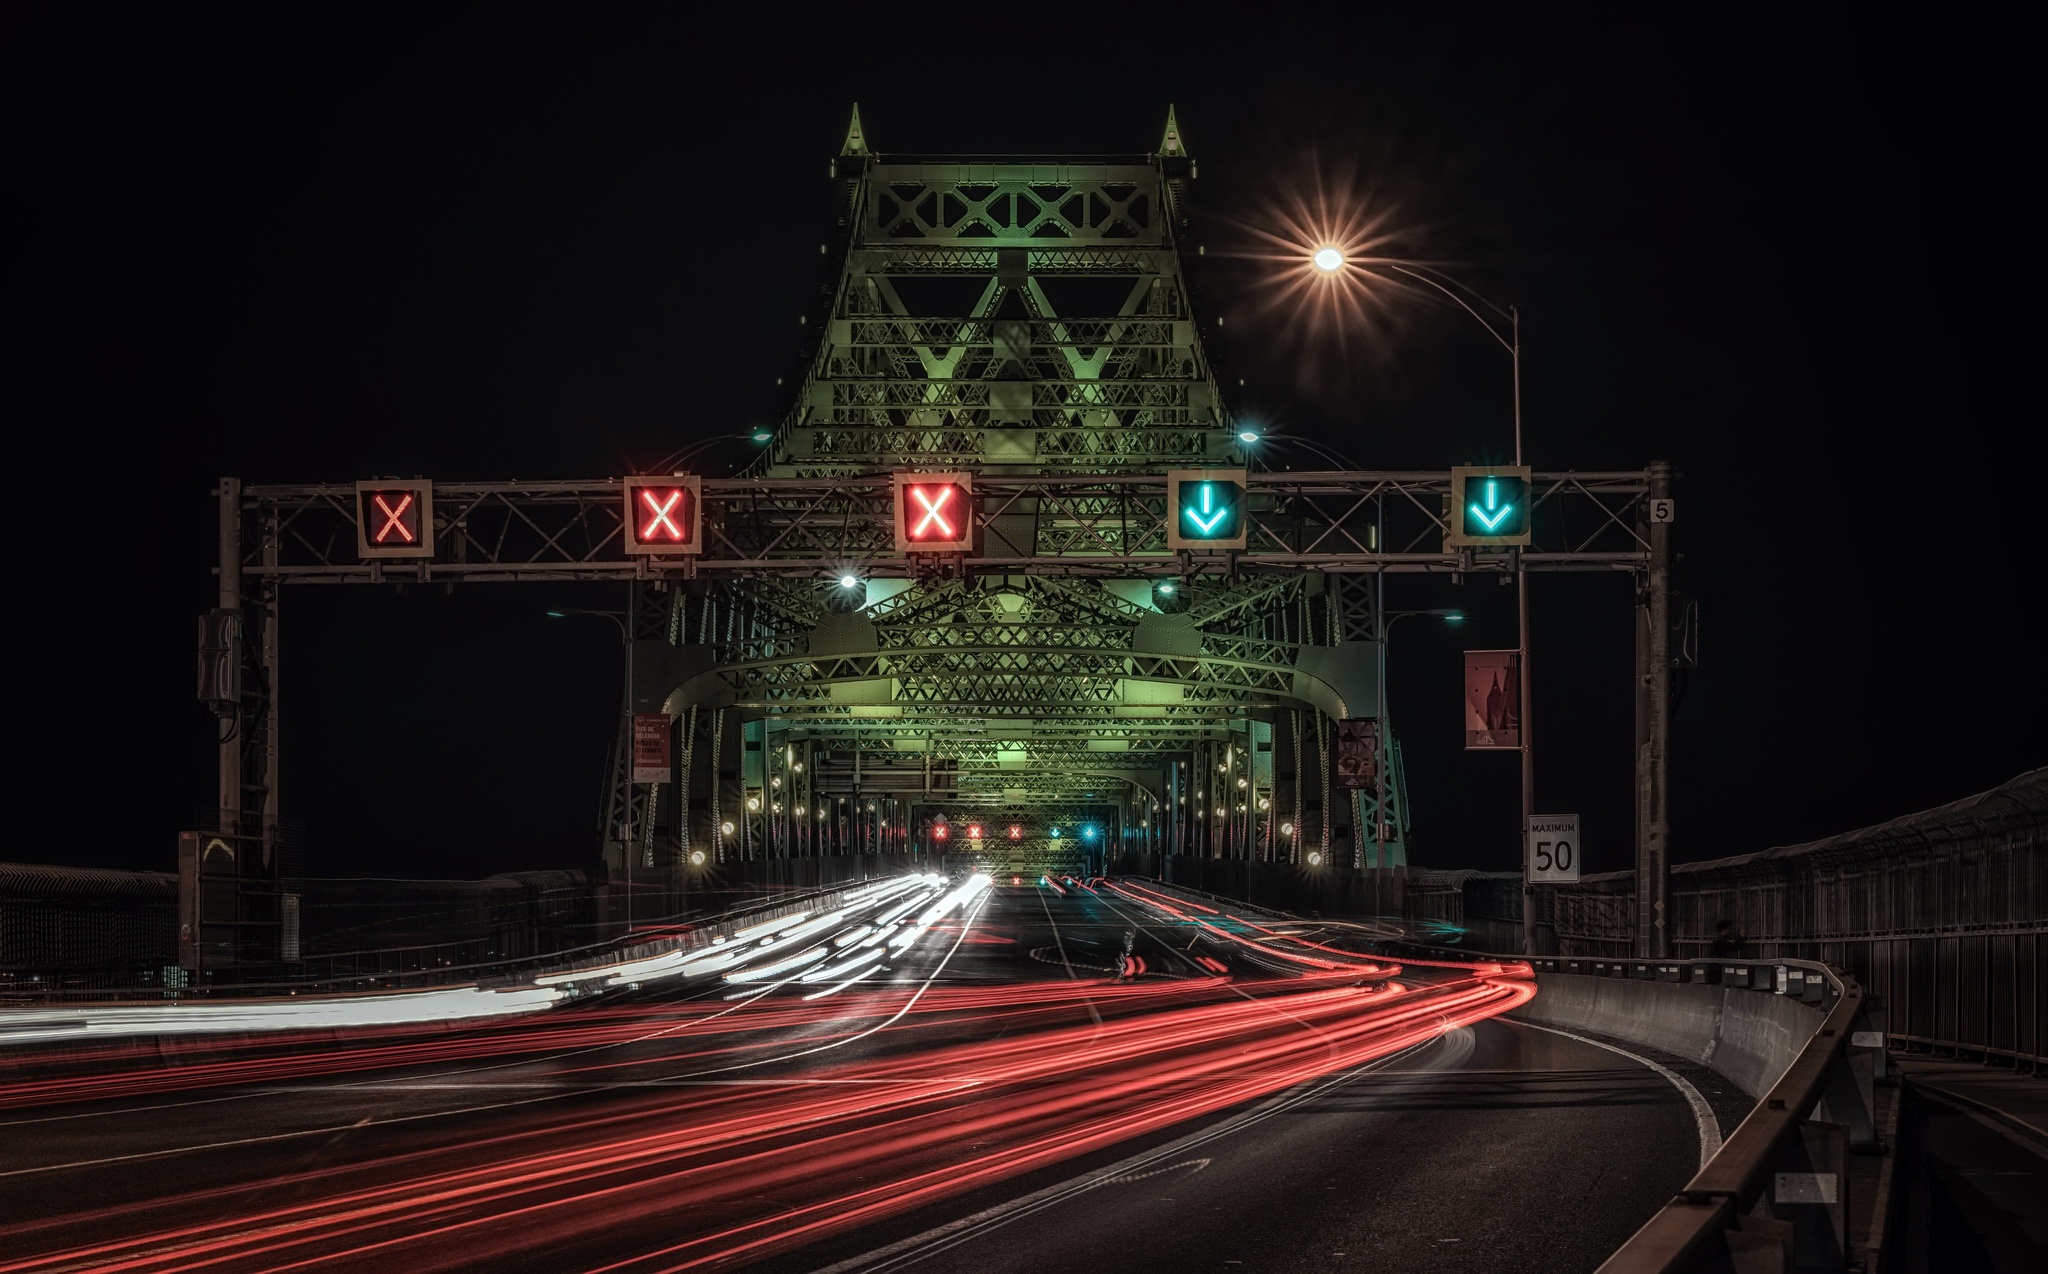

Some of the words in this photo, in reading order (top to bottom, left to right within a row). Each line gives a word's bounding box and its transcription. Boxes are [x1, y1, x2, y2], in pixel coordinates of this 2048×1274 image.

[1655, 502, 1669, 519] 5
[1532, 824, 1575, 833] MAXIMUM
[1536, 840, 1572, 872] 50
